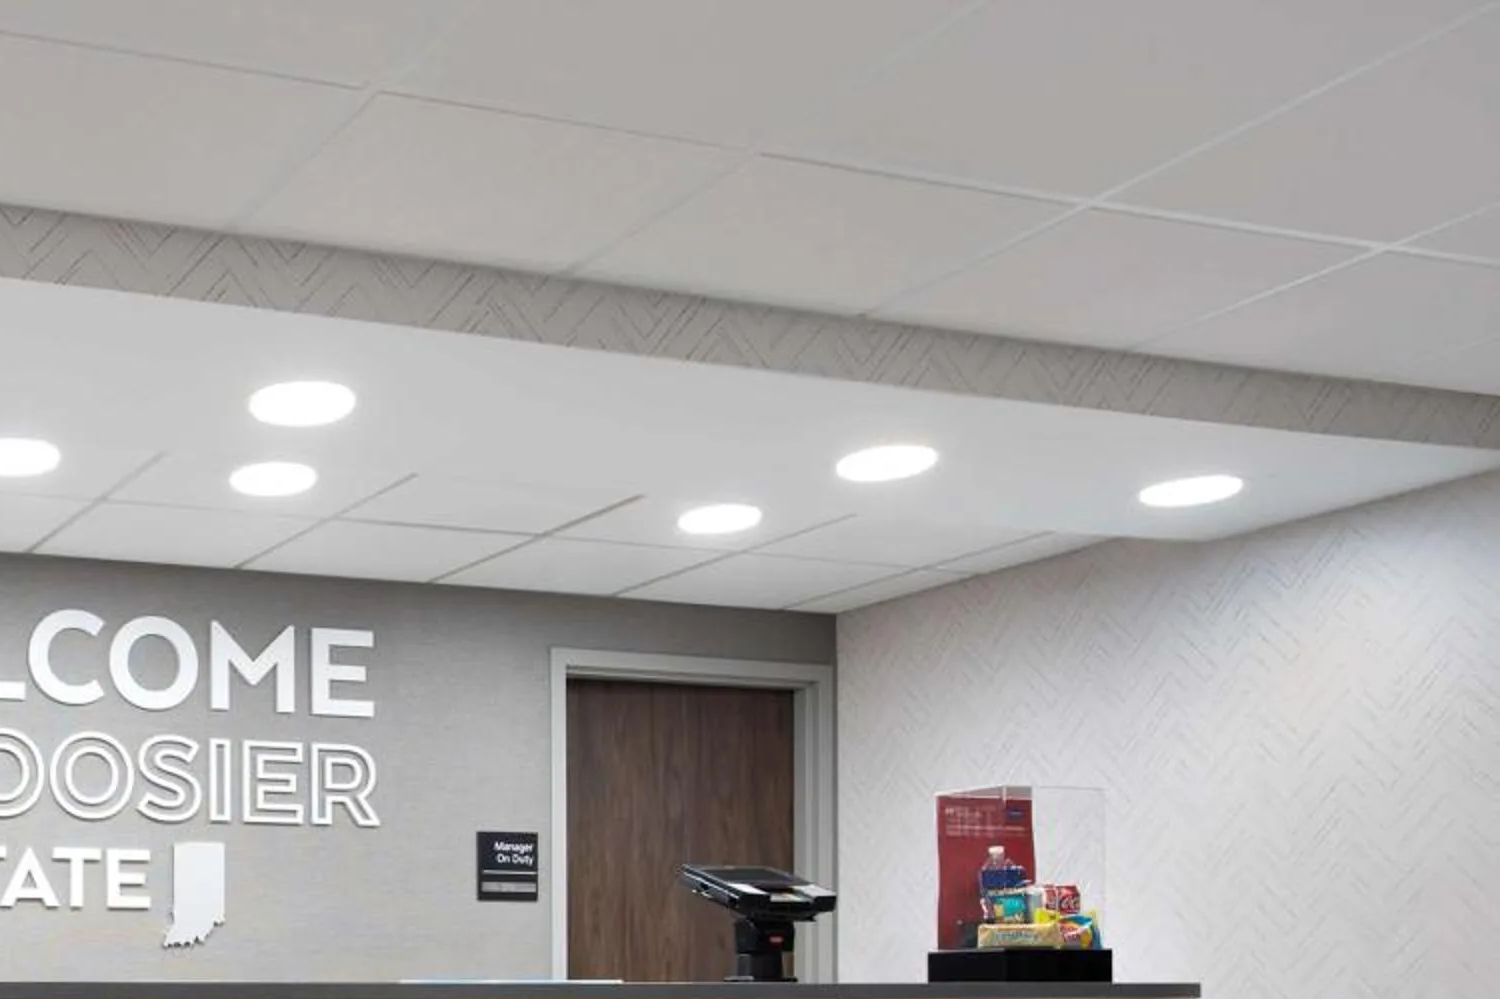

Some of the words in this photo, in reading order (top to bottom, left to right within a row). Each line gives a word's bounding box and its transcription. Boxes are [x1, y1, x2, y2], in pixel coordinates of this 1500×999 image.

[494, 841, 533, 854] Manager
[497, 853, 511, 863] On
[512, 853, 533, 866] Duty
